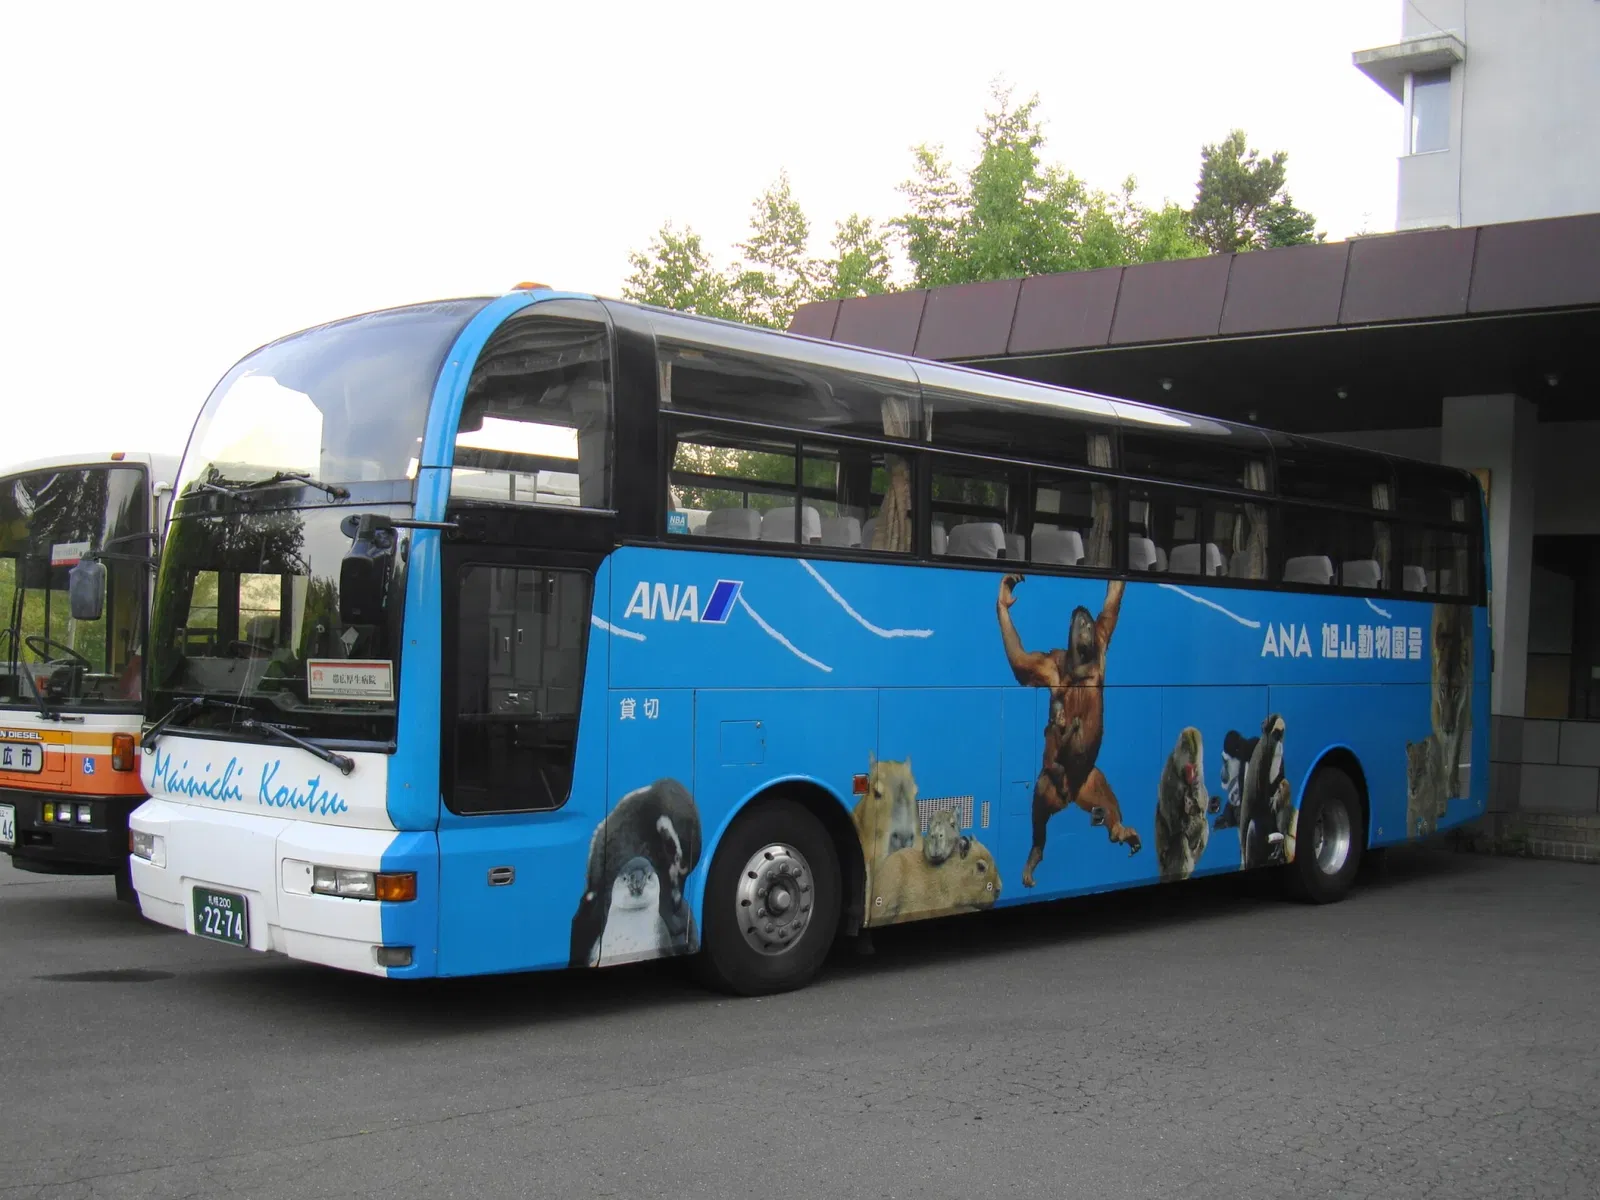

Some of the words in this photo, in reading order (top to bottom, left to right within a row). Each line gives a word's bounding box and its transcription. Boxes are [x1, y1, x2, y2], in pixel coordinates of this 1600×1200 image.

[624, 581, 699, 622] ANA
[1261, 622, 1312, 658] ANA
[1322, 622, 1422, 659] 旭山動物園号
[619, 698, 659, 720] 貸切
[8, 731, 43, 740] DIESEL
[151, 747, 243, 803] Mainichi
[258, 760, 348, 816] Koutsu
